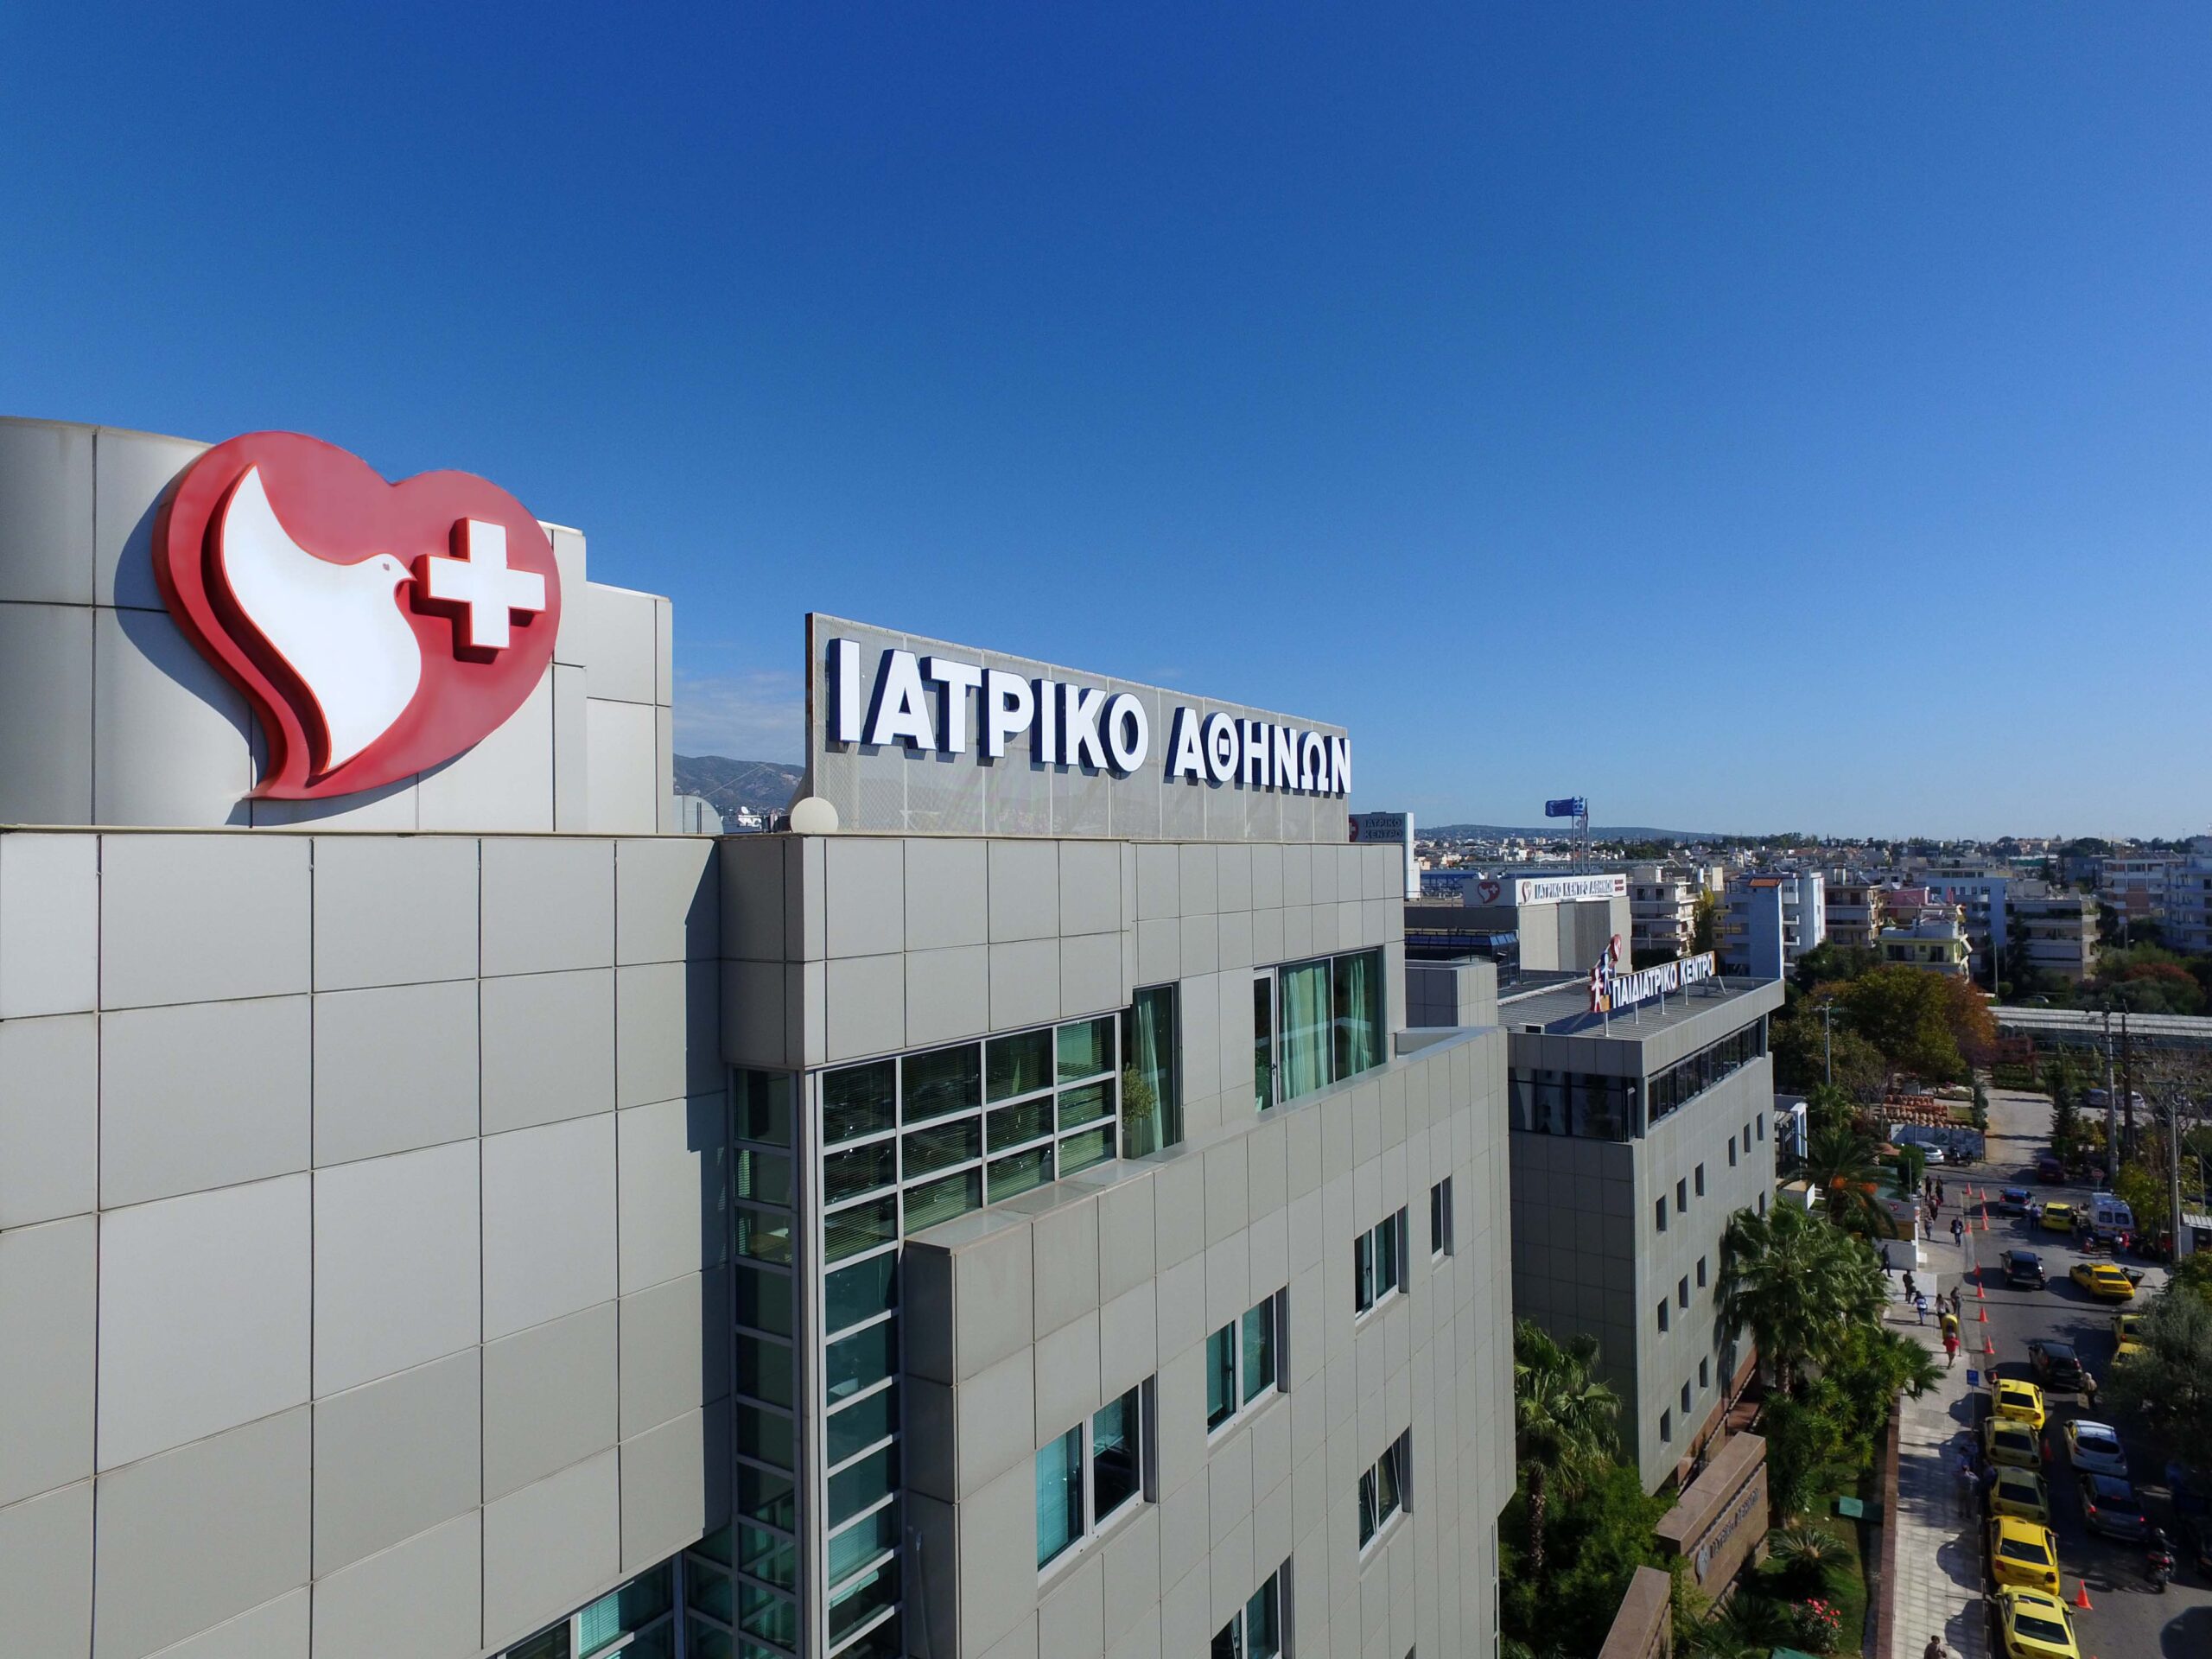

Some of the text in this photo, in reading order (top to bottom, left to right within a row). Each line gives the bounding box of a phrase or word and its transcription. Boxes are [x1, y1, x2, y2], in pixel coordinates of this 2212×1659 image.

[830, 638, 1351, 793] ΙΑΤΡΙΚΟ ΑΘΗΝΩΝ
[1364, 818, 1402, 828] ΙΑΤΡΙΚΟ
[1365, 830, 1402, 839] ΚΕΝΤΡΟ
[1534, 883, 1561, 899] ΙΑΤΡΙΚΟ
[1563, 881, 1588, 896] ΚΕΝΤΡΟ
[1612, 953, 1713, 1008] ΠΑΙΔΙΑΤΡΙΚΟ ΚΕΝΤΡΟ
